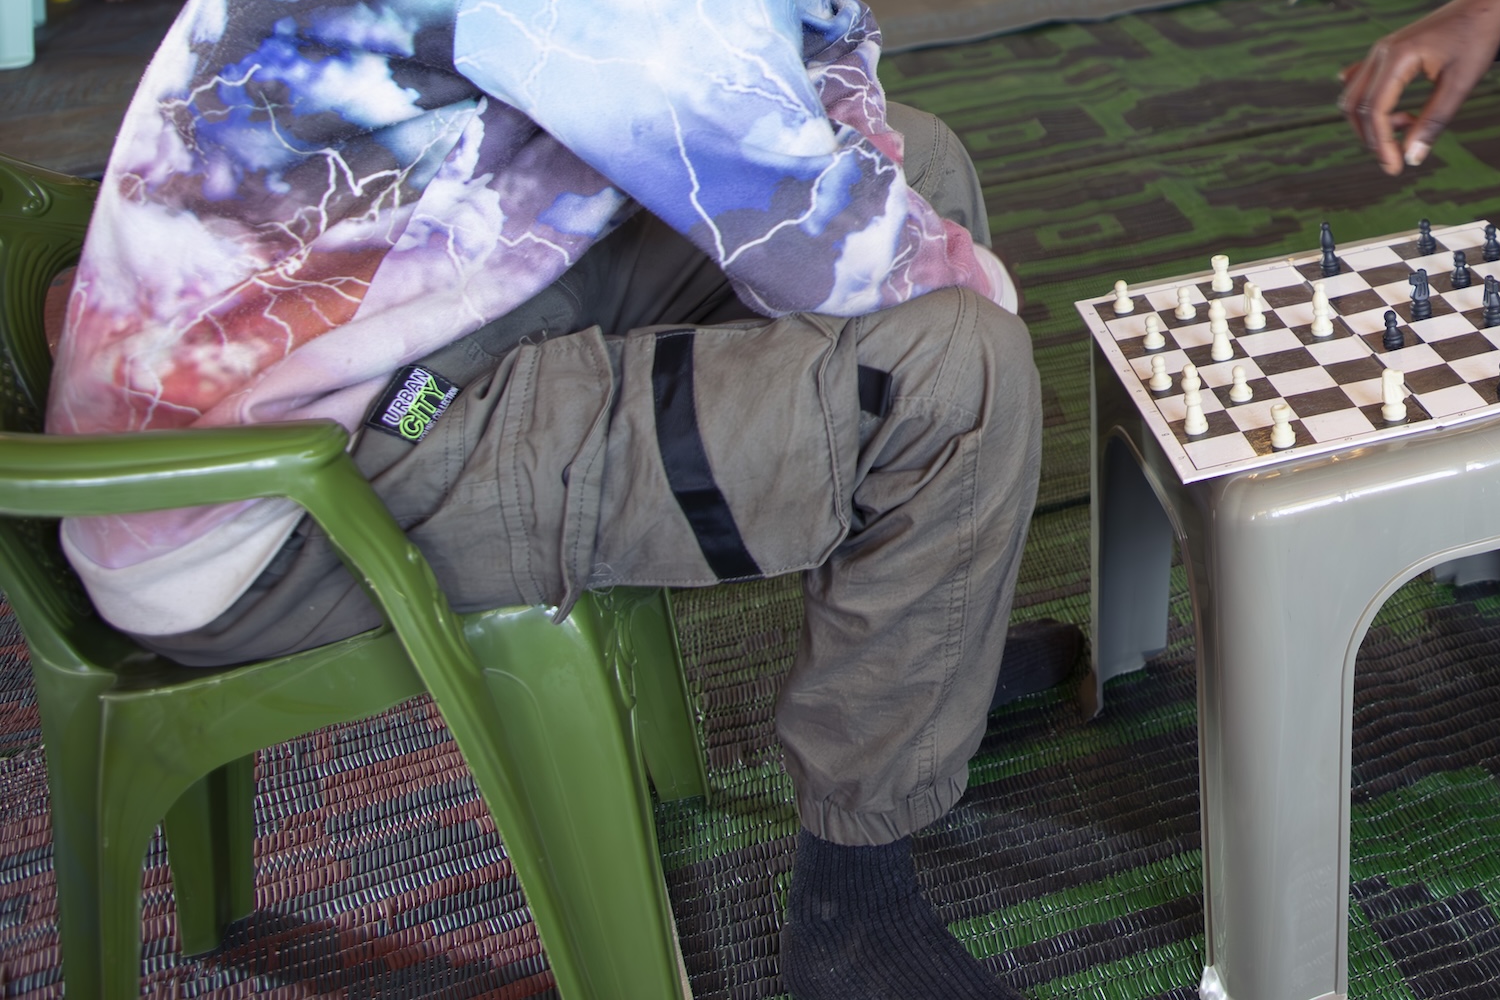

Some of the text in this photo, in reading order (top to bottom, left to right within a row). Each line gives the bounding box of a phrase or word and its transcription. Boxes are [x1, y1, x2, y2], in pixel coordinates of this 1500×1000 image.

[382, 367, 431, 426] URBAN
[399, 375, 446, 439] CITY
[432, 386, 459, 421] COLLECTION
